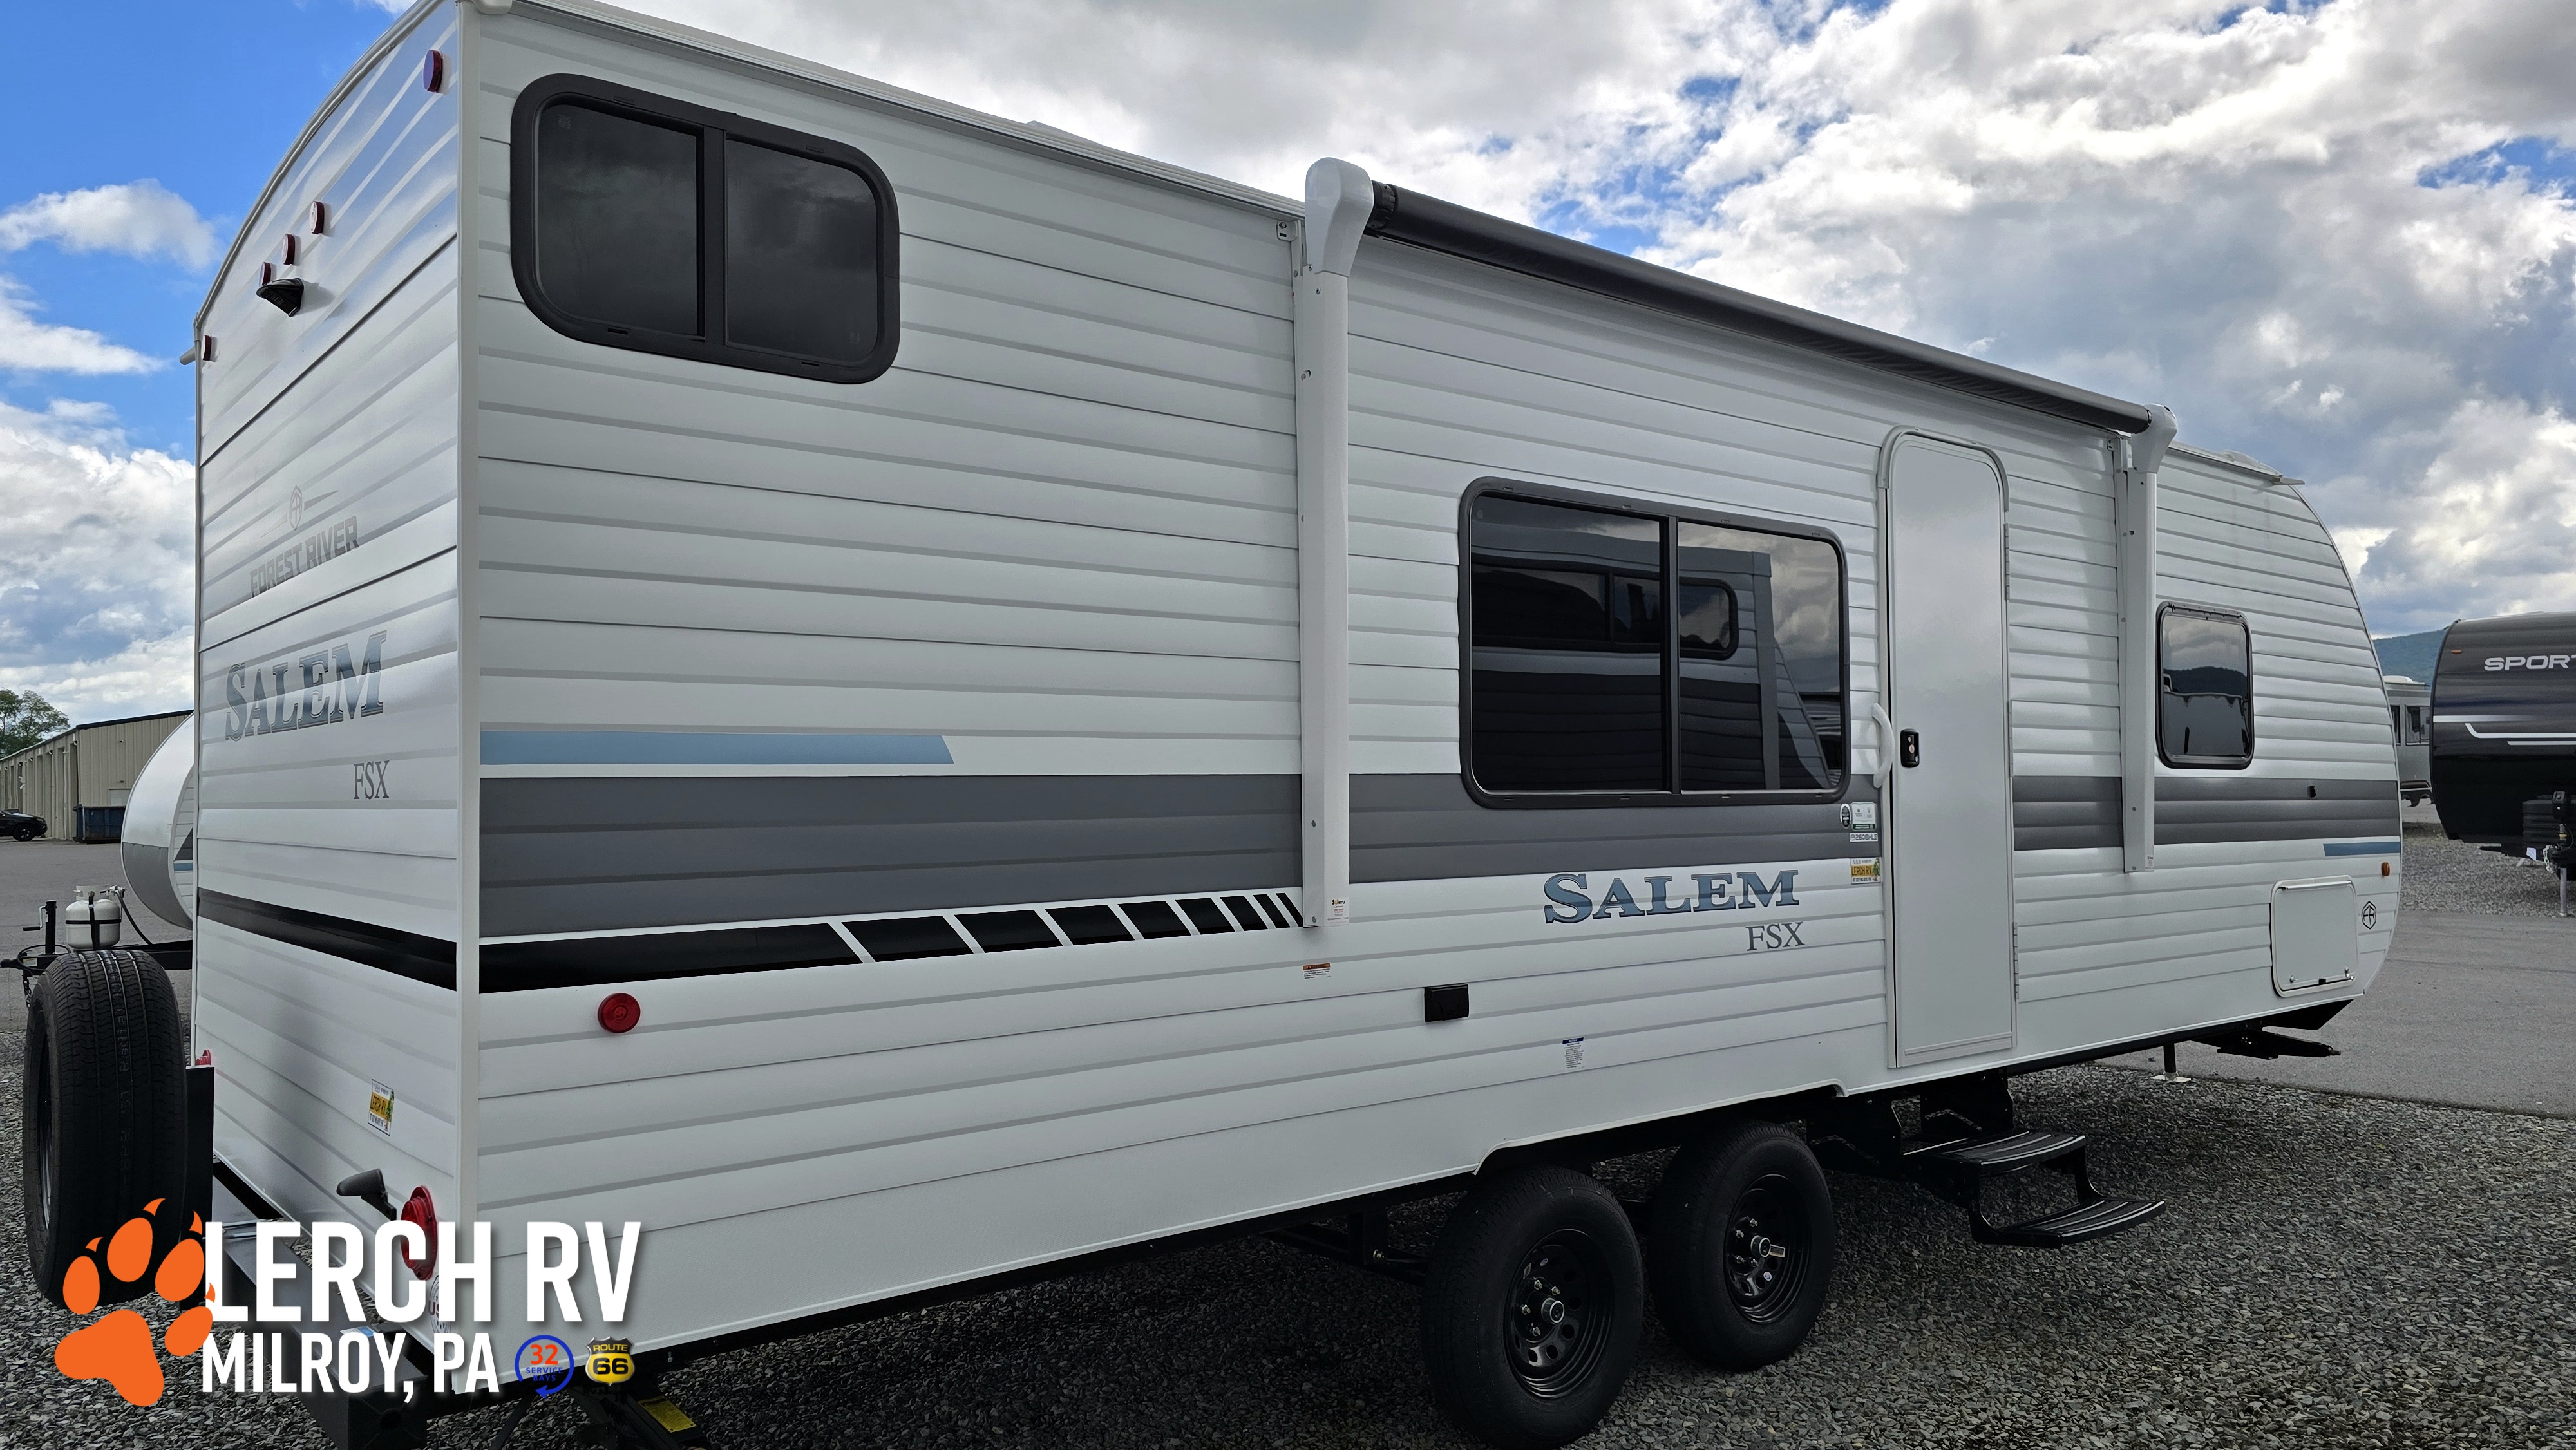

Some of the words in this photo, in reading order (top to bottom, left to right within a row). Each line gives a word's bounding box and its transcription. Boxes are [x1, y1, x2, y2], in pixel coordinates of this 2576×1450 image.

[249, 546, 303, 598] FOREST
[305, 515, 359, 571] RIVER
[225, 629, 387, 742] SALEM
[353, 760, 390, 800] FSX
[1544, 869, 1800, 924] SALEM
[1745, 921, 1805, 952] FSX
